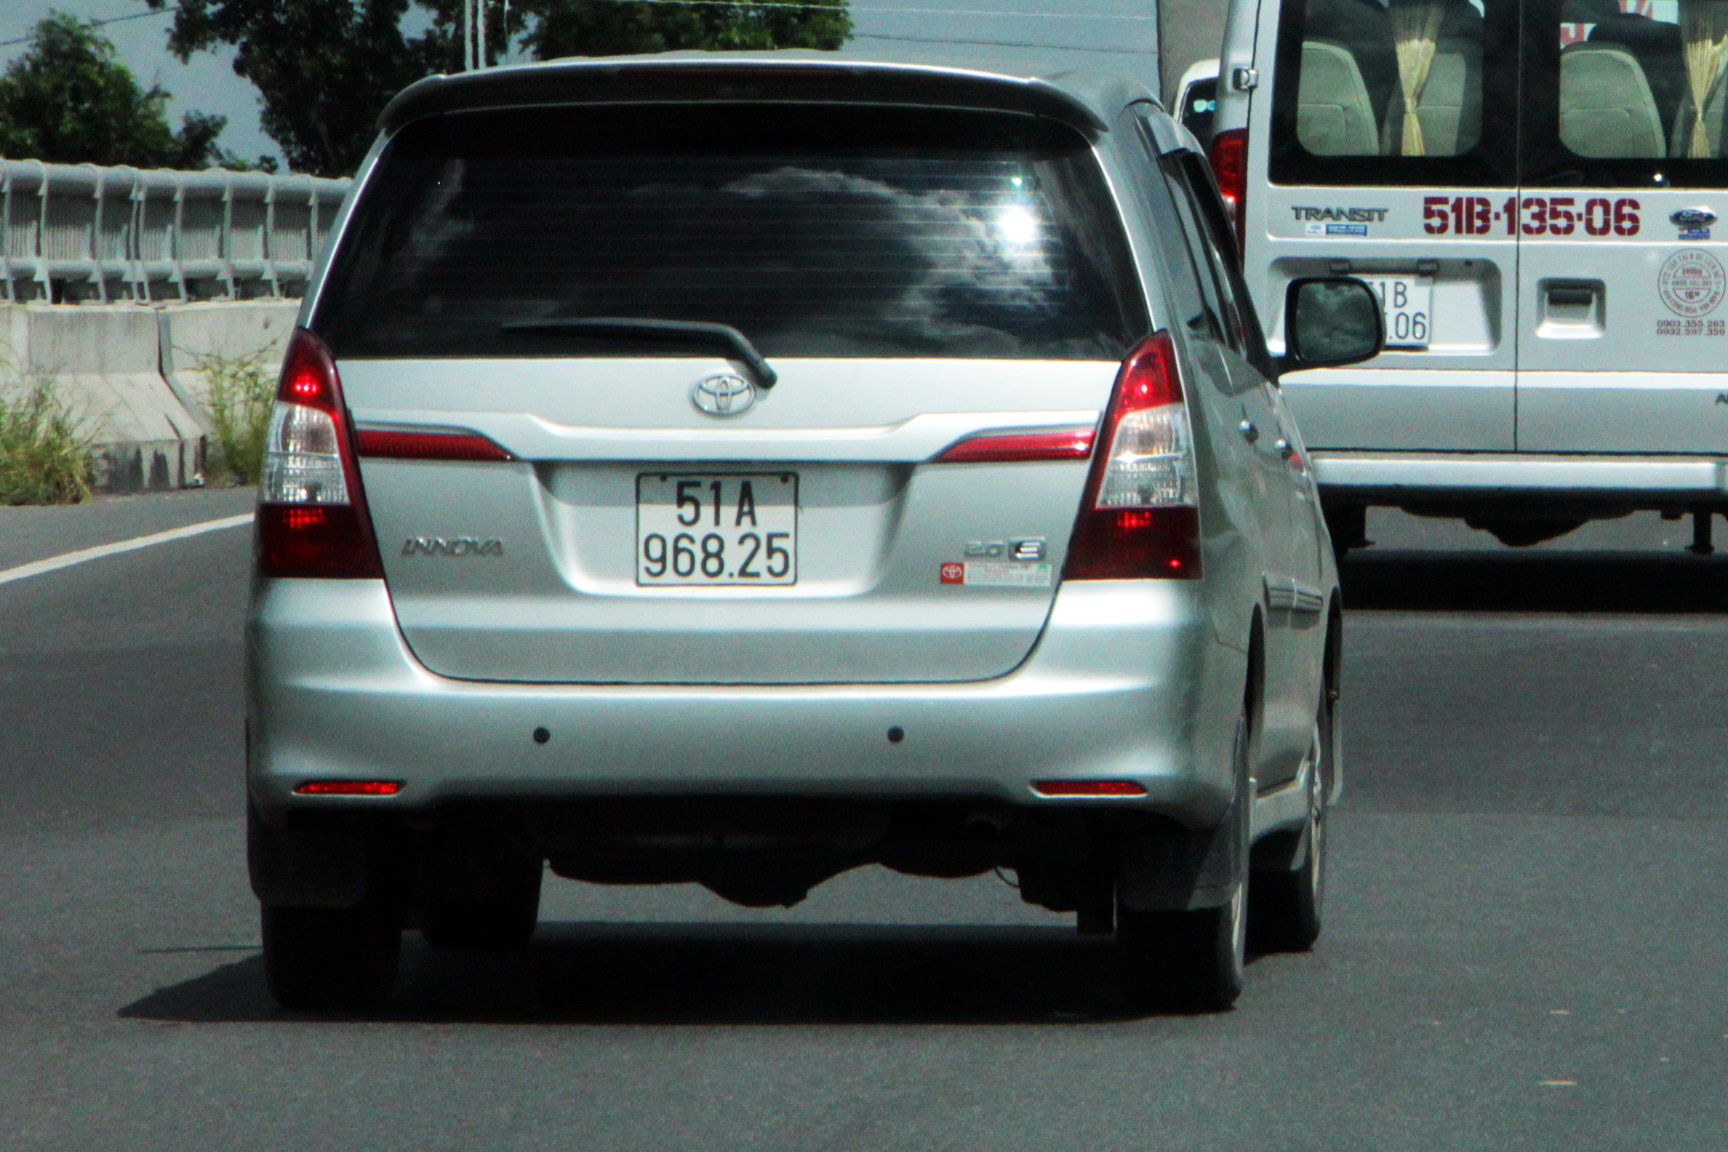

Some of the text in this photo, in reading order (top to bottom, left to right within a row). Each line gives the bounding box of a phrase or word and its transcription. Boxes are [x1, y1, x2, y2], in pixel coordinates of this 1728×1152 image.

[1291, 205, 1389, 223] TRANSIT
[1369, 281, 1408, 308] 1B
[676, 480, 757, 527] 51A
[401, 536, 504, 557] INNOVA
[643, 532, 790, 578] 968.25
